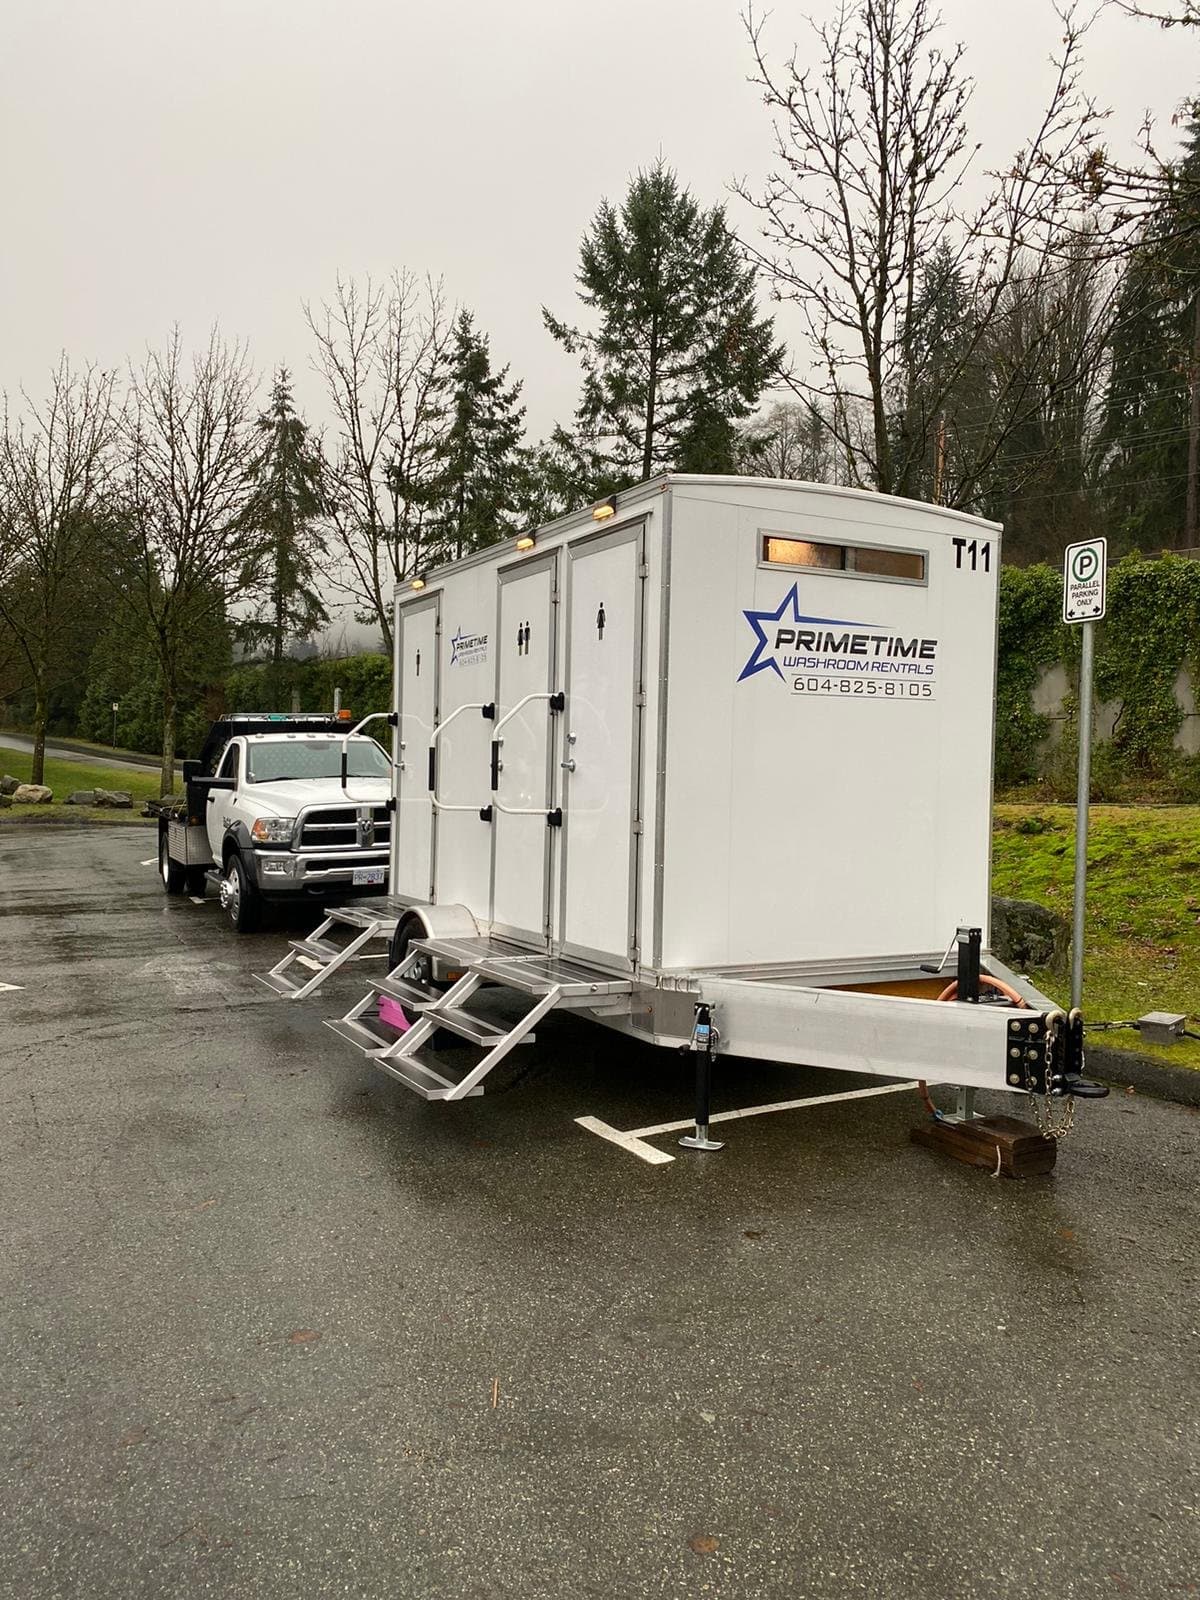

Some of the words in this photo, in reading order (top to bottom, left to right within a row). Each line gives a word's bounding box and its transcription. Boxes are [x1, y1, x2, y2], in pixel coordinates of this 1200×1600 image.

[952, 538, 991, 572] T11
[1079, 556, 1092, 575] P
[1070, 581, 1100, 590] PARALLEL
[1071, 589, 1099, 599] PARKING
[1076, 598, 1093, 607] ONLY
[774, 629, 938, 660] PRIMETIME
[783, 655, 870, 673] WASHROOM
[871, 661, 935, 675] RENTALS
[793, 677, 933, 698] 604-825-8105
